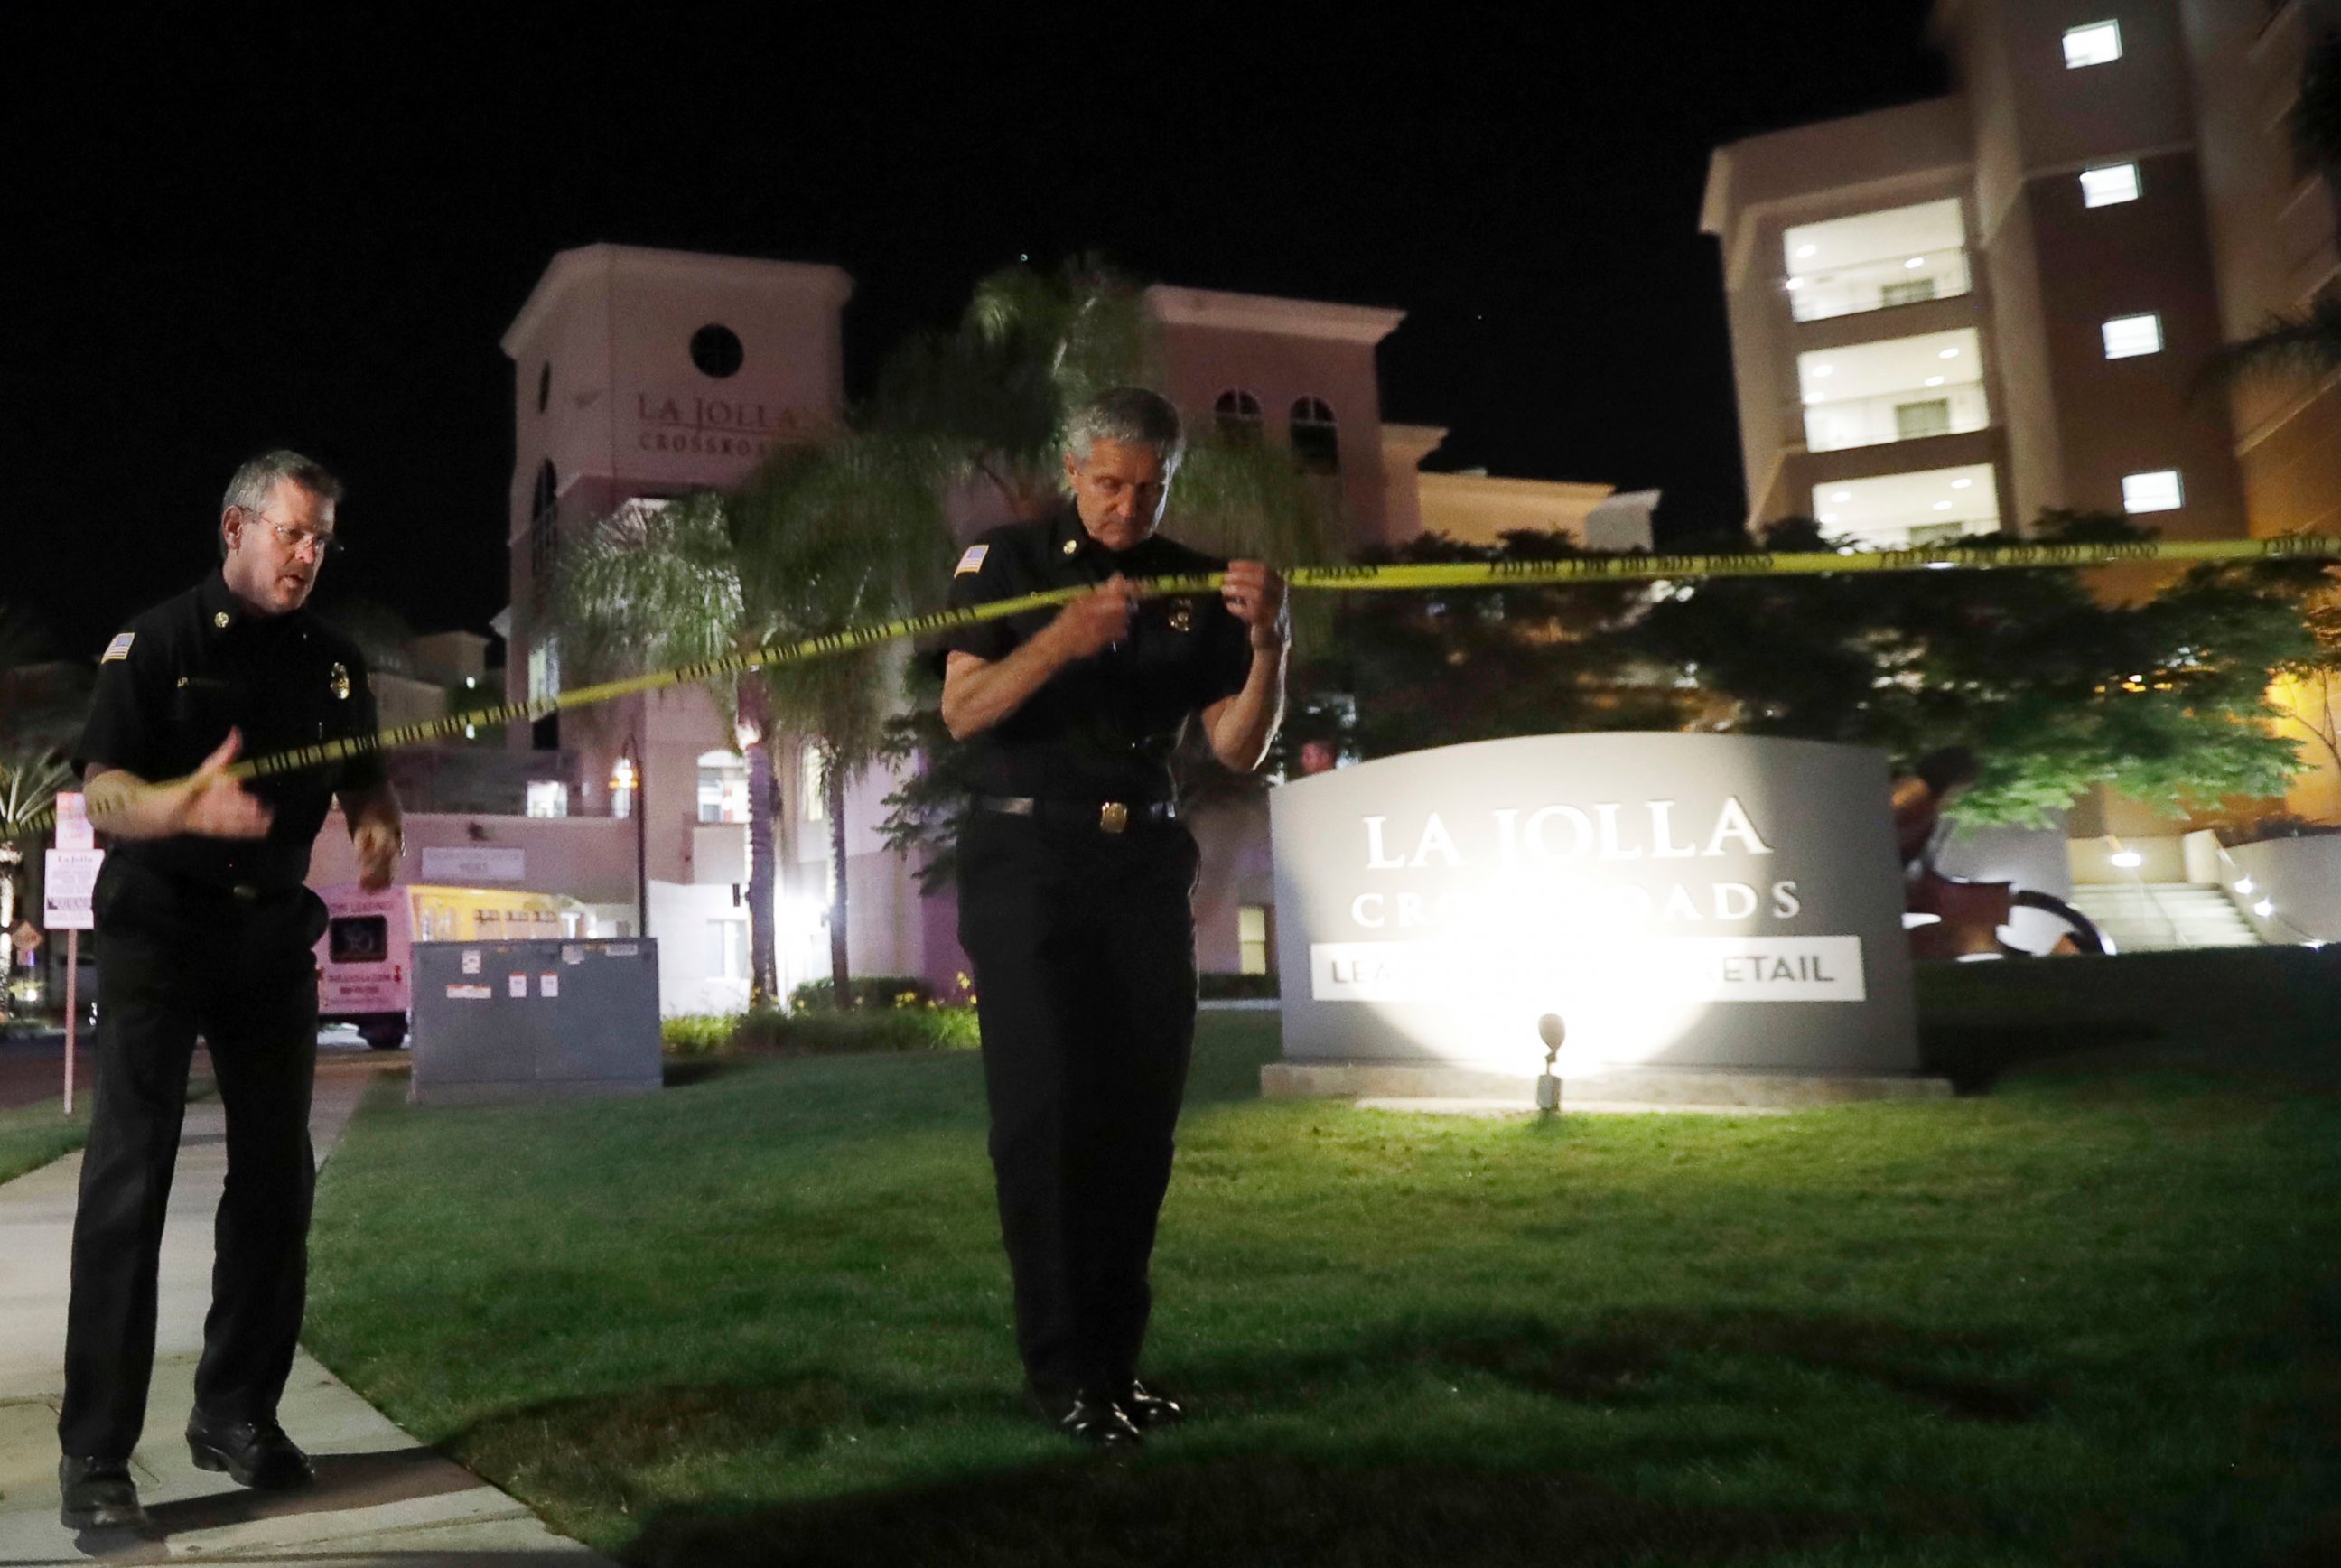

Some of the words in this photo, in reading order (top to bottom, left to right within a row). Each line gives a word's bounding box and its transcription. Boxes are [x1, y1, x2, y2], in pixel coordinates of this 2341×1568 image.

[638, 393, 680, 421] LA
[1360, 811, 1470, 870] LA
[1492, 796, 1774, 867] JOLLA
